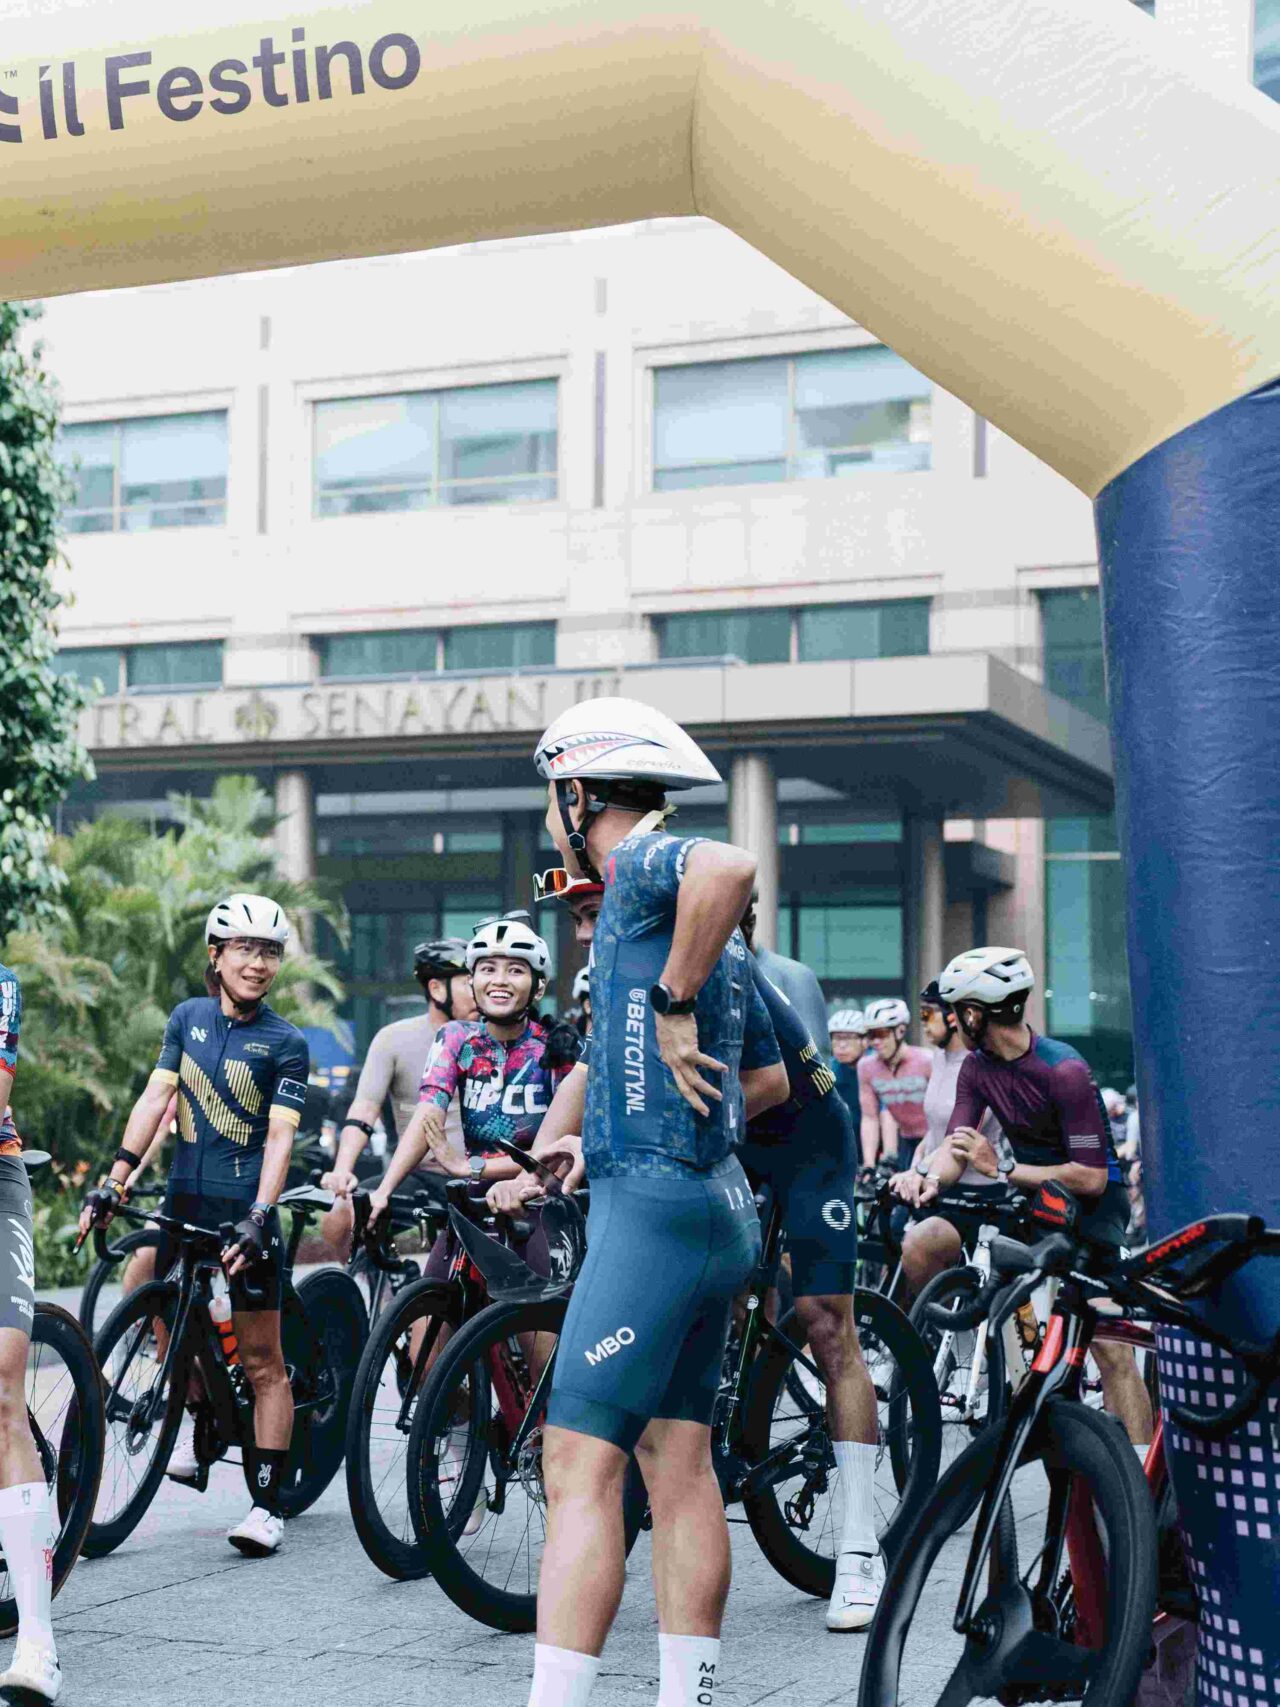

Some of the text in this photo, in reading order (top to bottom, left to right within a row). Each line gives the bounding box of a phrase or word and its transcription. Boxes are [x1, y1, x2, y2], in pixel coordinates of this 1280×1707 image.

[104, 27, 421, 131] Festino
[84, 698, 214, 746] TRAL
[301, 678, 547, 738] SENAYAN
[624, 1002, 646, 1116] BETCITY.NL
[463, 1078, 548, 1115] KPCC
[583, 1326, 636, 1366] MBO
